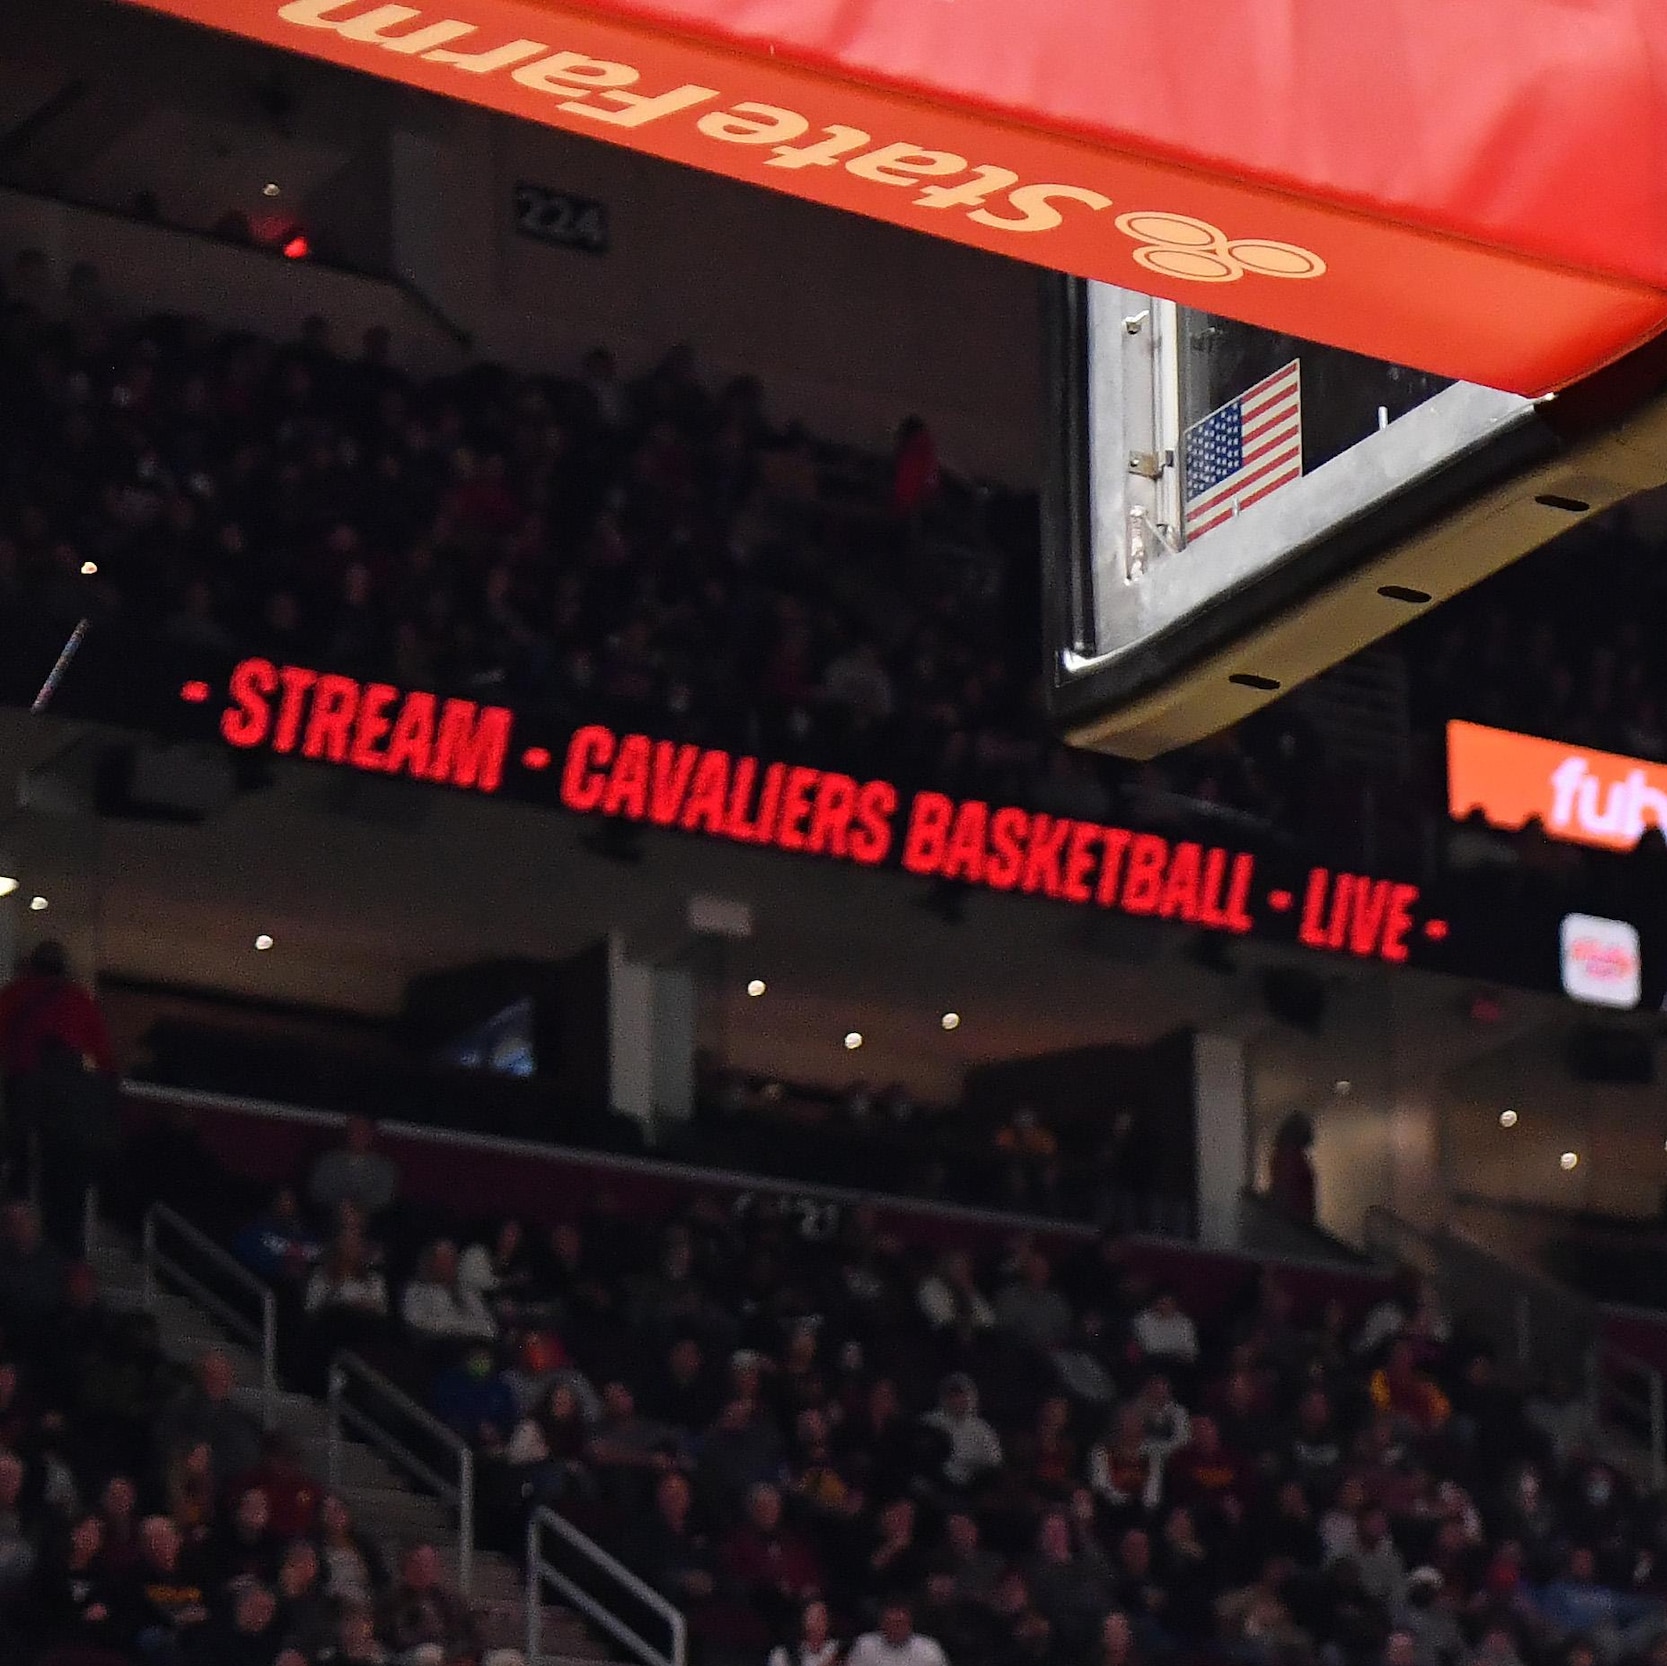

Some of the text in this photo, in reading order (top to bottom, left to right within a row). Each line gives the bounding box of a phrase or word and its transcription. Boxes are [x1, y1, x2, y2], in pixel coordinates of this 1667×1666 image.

[222, 657, 1416, 961] STREAM CAVALIERS BASKETBALL LIVE
